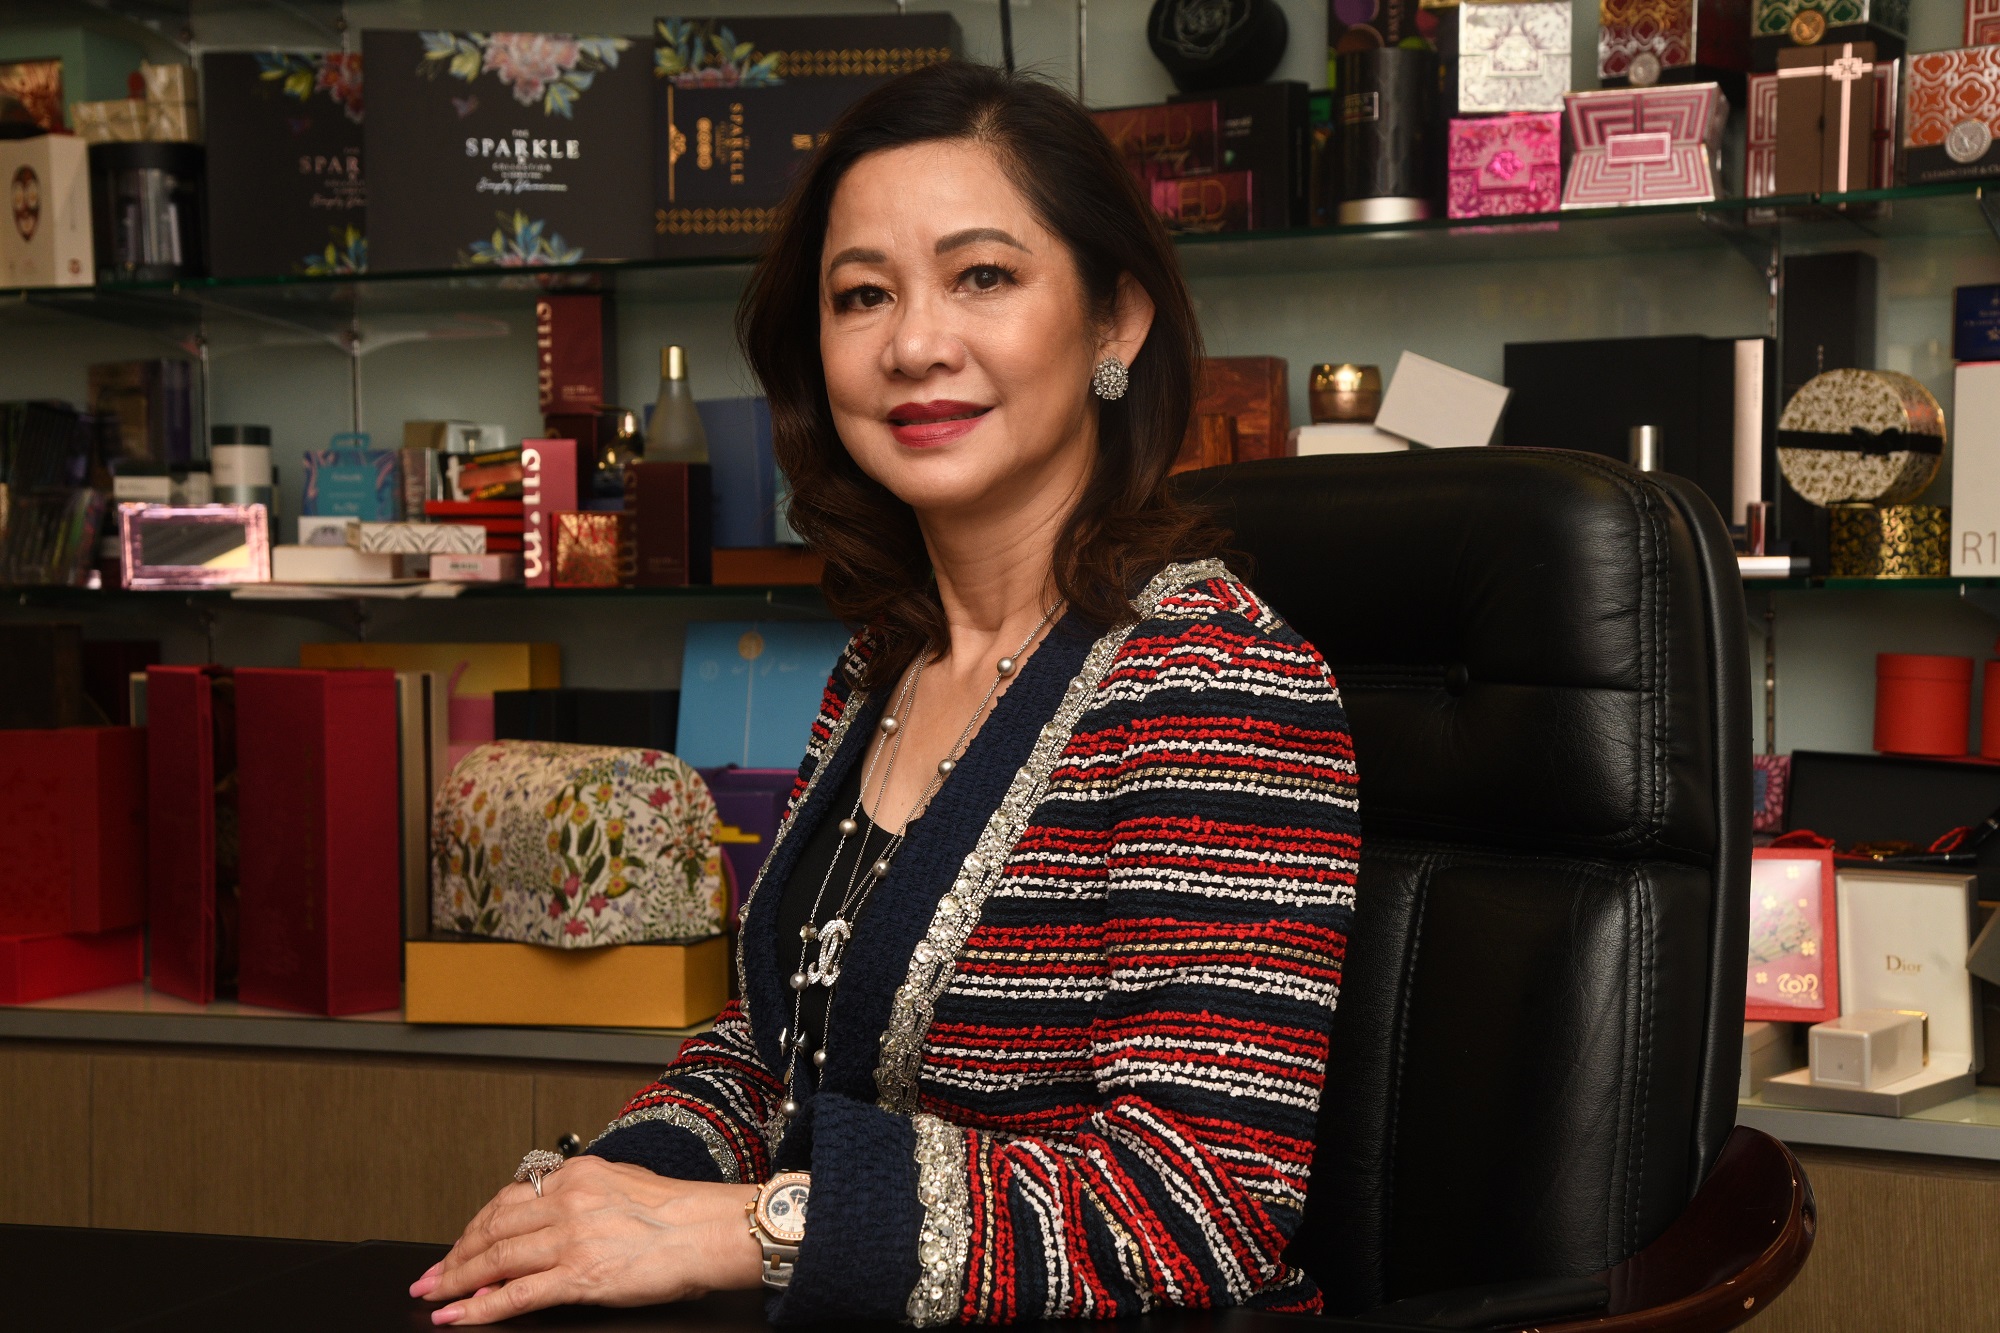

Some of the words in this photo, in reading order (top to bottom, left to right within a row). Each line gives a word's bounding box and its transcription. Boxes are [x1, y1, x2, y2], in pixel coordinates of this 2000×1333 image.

[465, 137, 580, 159] SPARKLE
[729, 103, 745, 185] SPARKLE
[1886, 954, 1922, 973] Dior
